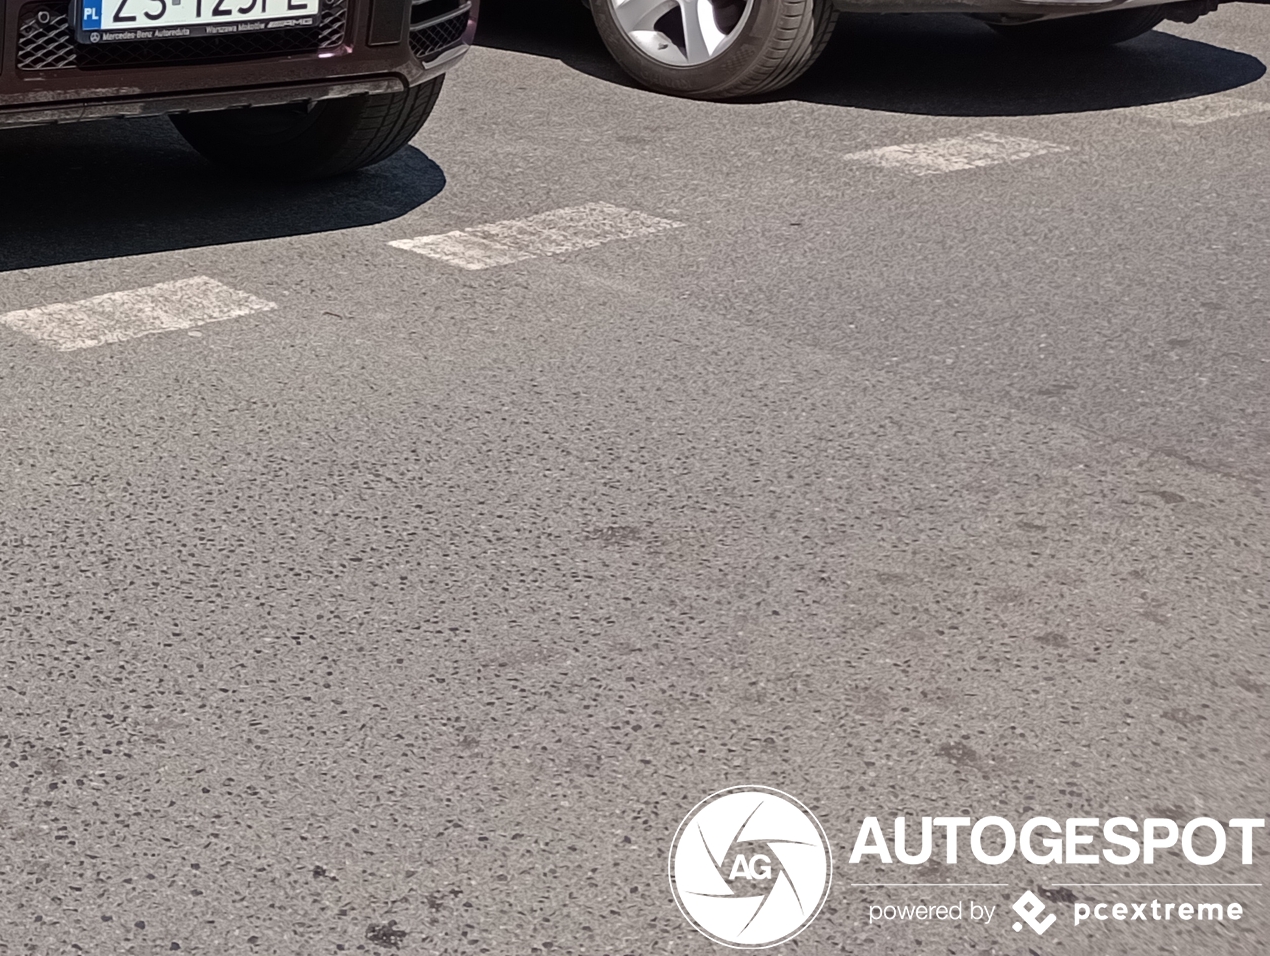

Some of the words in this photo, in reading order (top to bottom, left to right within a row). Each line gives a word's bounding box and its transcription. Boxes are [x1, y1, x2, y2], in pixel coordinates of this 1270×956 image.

[83, 7, 99, 20] PL
[102, 29, 153, 41] Mercedes-Benz
[206, 24, 237, 34] Warszawa
